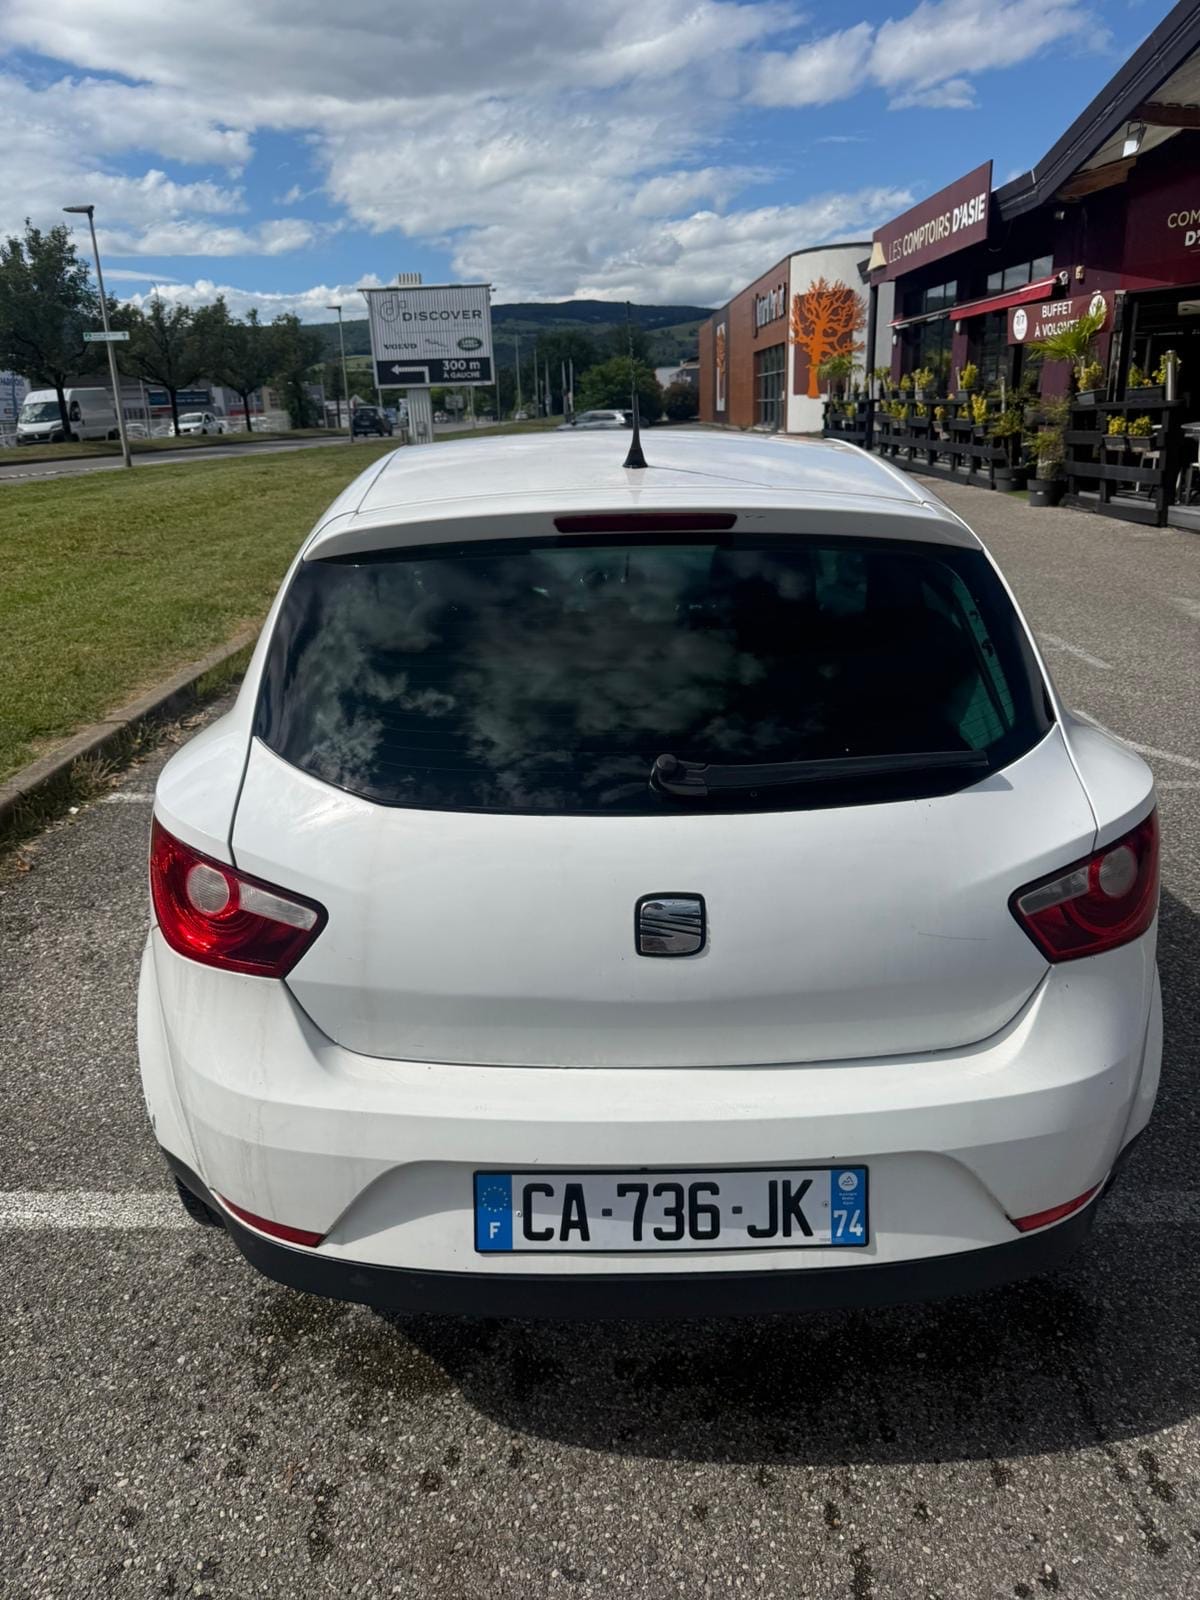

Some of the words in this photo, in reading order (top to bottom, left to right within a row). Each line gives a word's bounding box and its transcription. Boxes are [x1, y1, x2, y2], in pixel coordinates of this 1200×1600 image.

[888, 238, 902, 264] LES
[902, 212, 951, 257] COMPTOIRS
[951, 192, 987, 234] D'ASIE
[402, 309, 483, 322] DISCOVER
[1041, 300, 1073, 318] BUFFET
[442, 359, 467, 370] 300
[469, 361, 481, 370] m
[489, 1222, 501, 1240] F
[833, 1209, 864, 1238] 74
